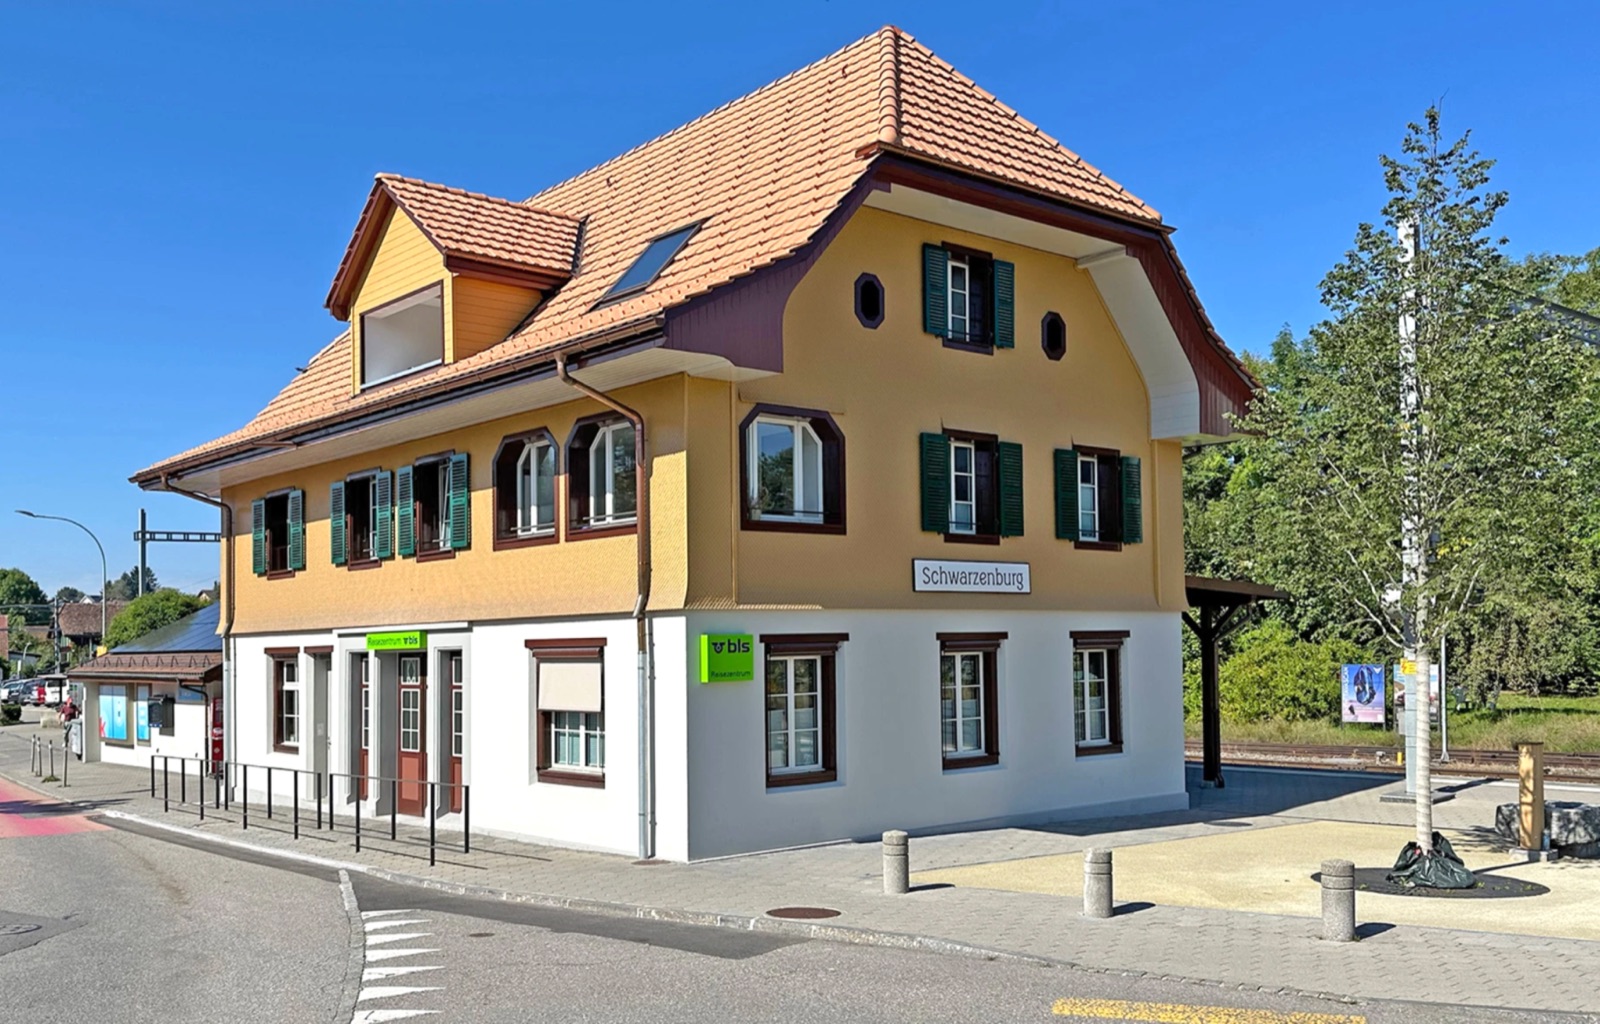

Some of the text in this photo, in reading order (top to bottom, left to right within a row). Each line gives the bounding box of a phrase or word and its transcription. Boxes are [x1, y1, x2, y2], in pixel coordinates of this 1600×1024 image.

[922, 566, 1024, 590] Schwarzenburg
[728, 638, 750, 653] bls
[710, 670, 750, 678] Reisezentrum
